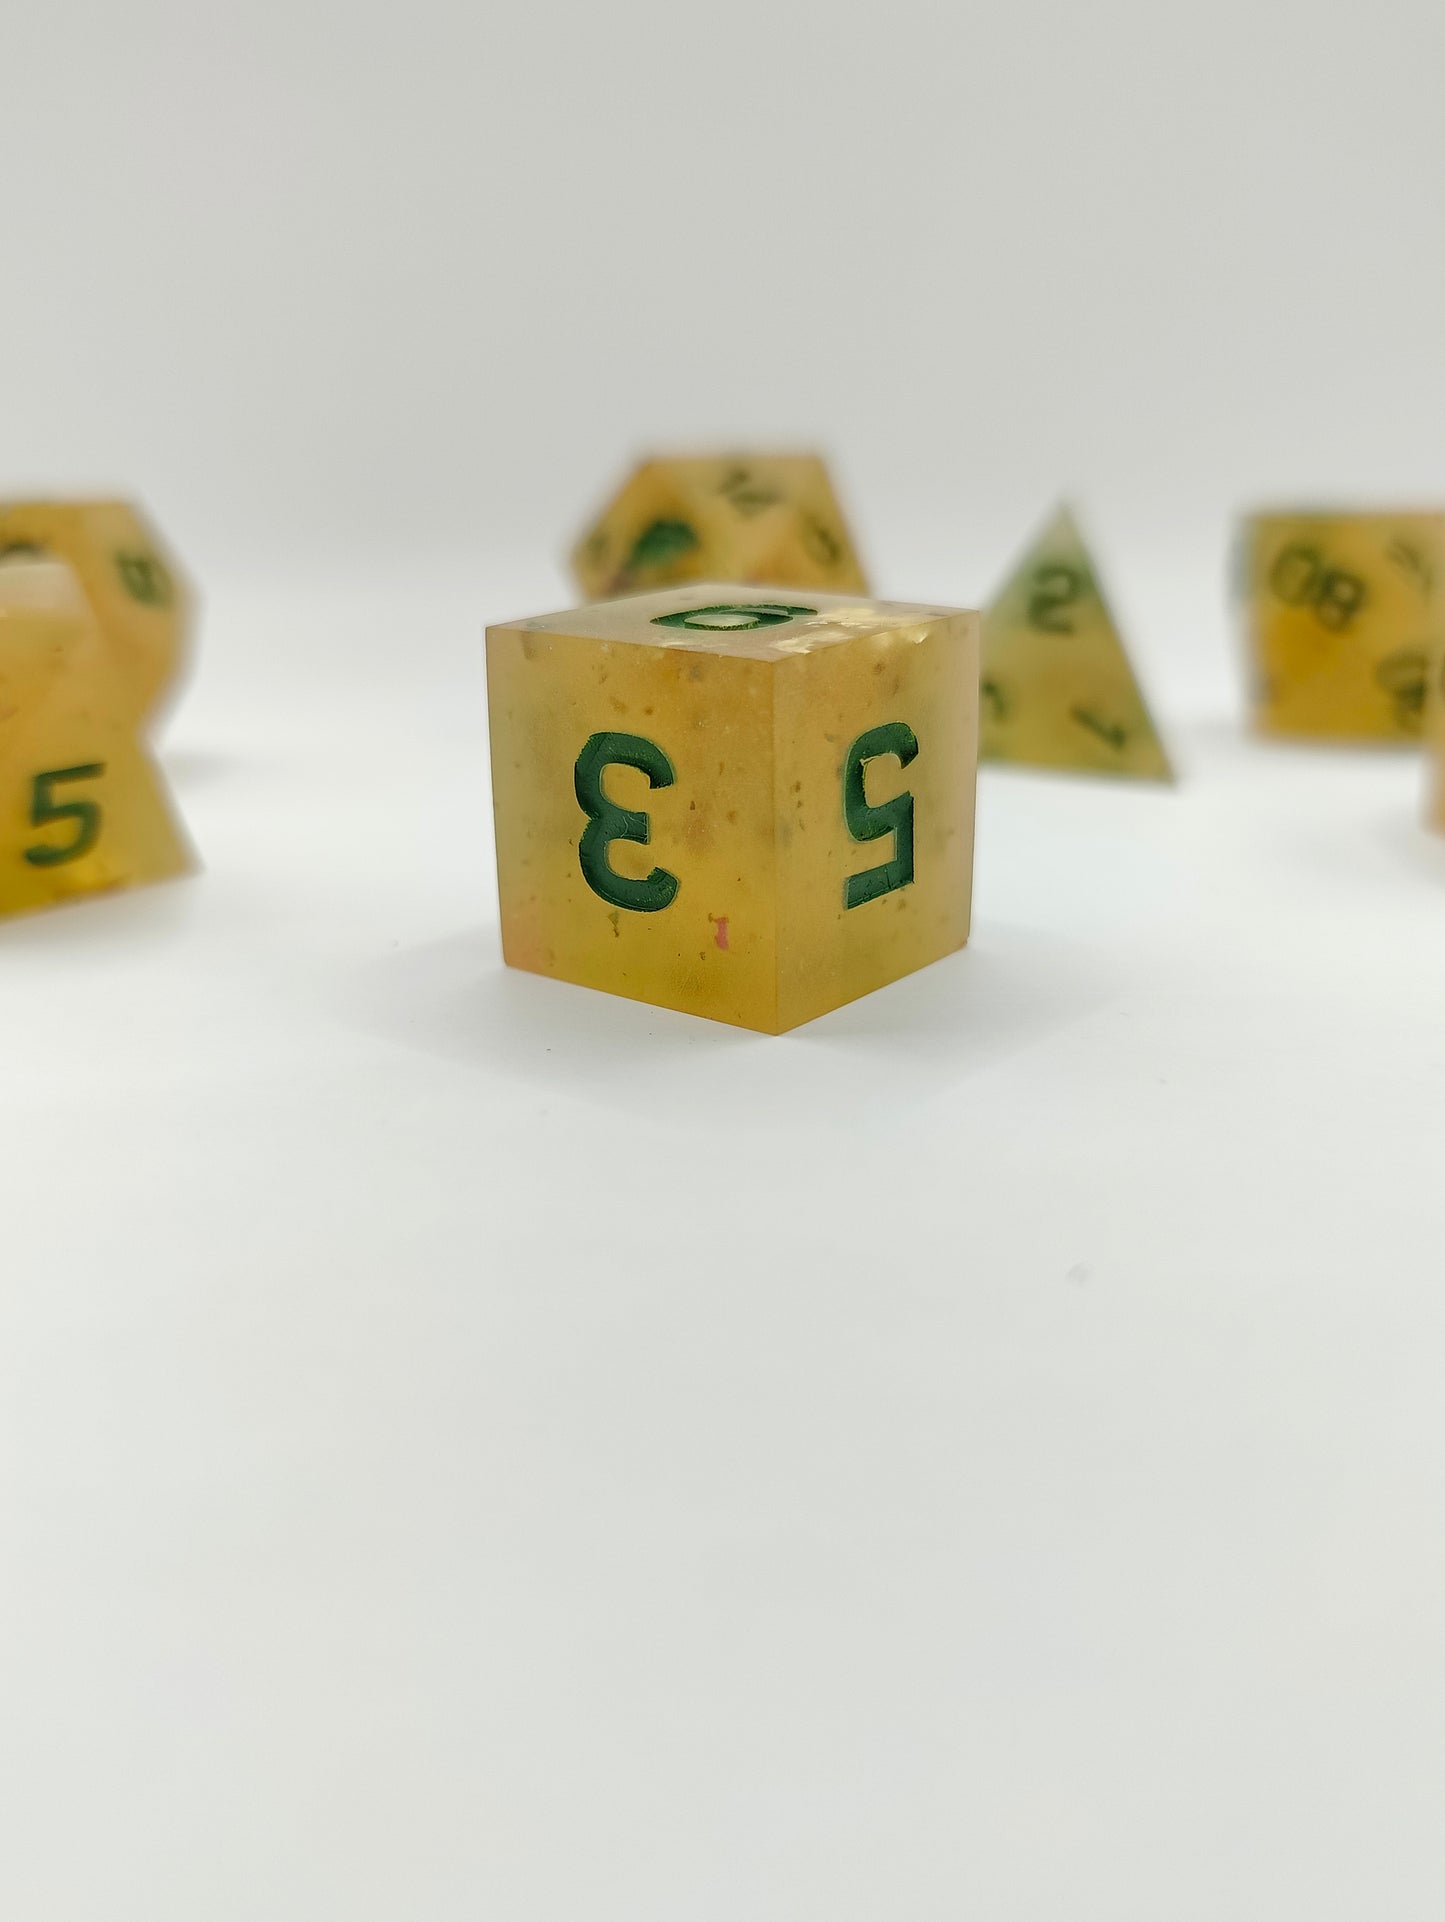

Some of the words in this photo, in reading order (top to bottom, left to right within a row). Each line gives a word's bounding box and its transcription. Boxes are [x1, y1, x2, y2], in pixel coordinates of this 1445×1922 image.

[1027, 565, 1083, 637] 2
[23, 762, 107, 868] 5
[574, 731, 678, 913] 3
[843, 721, 919, 911] 5
